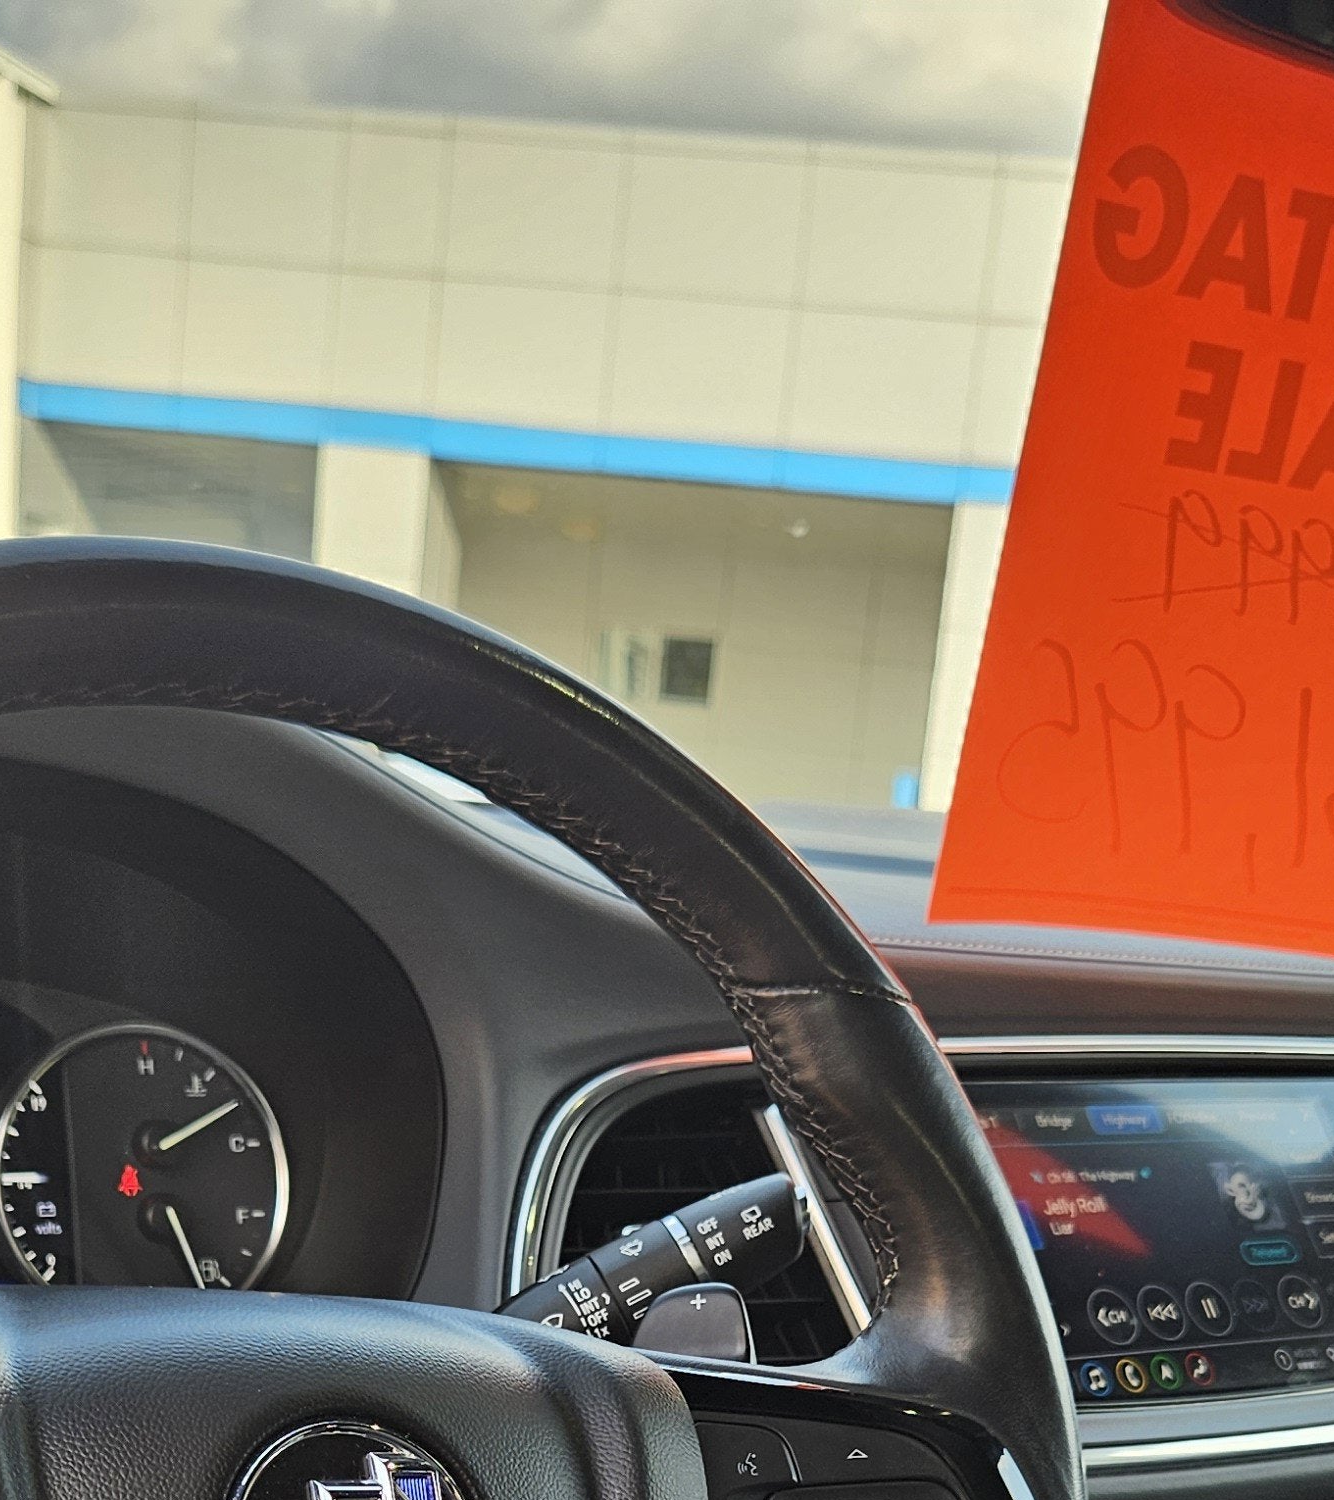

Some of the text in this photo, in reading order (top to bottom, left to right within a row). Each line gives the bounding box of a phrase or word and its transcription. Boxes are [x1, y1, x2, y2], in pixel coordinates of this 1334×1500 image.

[137, 1057, 156, 1076] H
[228, 1134, 246, 1153] C
[236, 1209, 249, 1225] F
[1043, 1197, 1076, 1218] Jelly
[696, 1216, 719, 1236] OFF
[742, 1217, 775, 1240] REAR
[705, 1232, 726, 1251] INT
[714, 1249, 732, 1266] ON
[573, 1285, 593, 1304] LO
